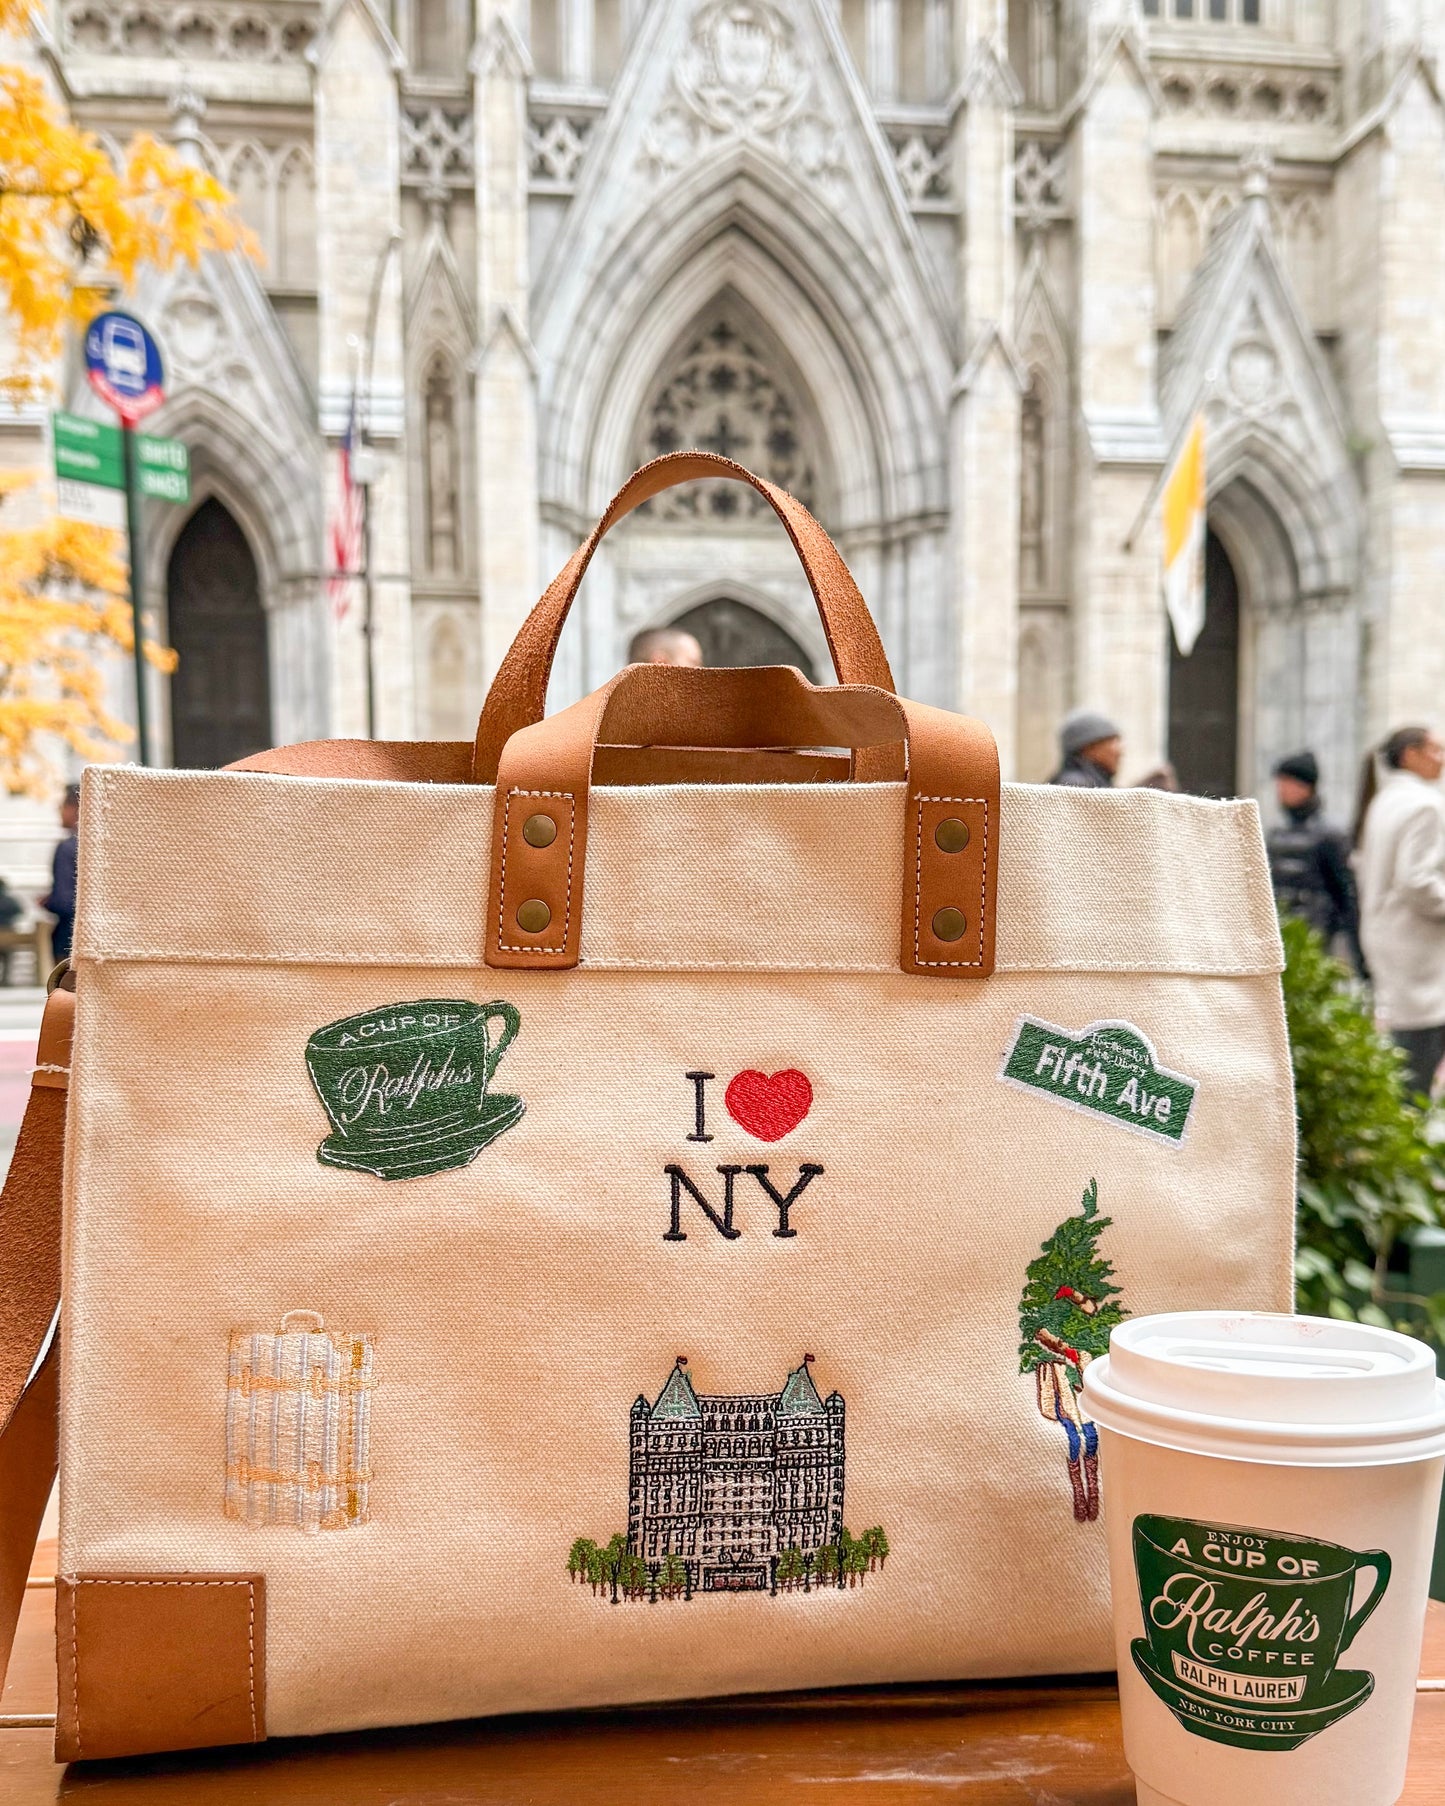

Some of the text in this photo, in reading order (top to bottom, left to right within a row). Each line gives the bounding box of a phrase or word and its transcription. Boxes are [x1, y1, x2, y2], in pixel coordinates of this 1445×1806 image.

[337, 1013, 461, 1047] A CUP OF
[1034, 1042, 1108, 1099] Fifth
[1116, 1077, 1172, 1124] Ave
[685, 1071, 716, 1144] I
[662, 1163, 825, 1241] NY
[1169, 1537, 1321, 1578] A CUP OF
[1206, 1530, 1269, 1550] ENJOY
[1150, 1572, 1320, 1664] Ralph's
[1208, 1642, 1315, 1666] COFFEE
[1180, 1659, 1298, 1700] RALPH LAUREN
[1178, 1697, 1297, 1732] NEW YORK CITY
